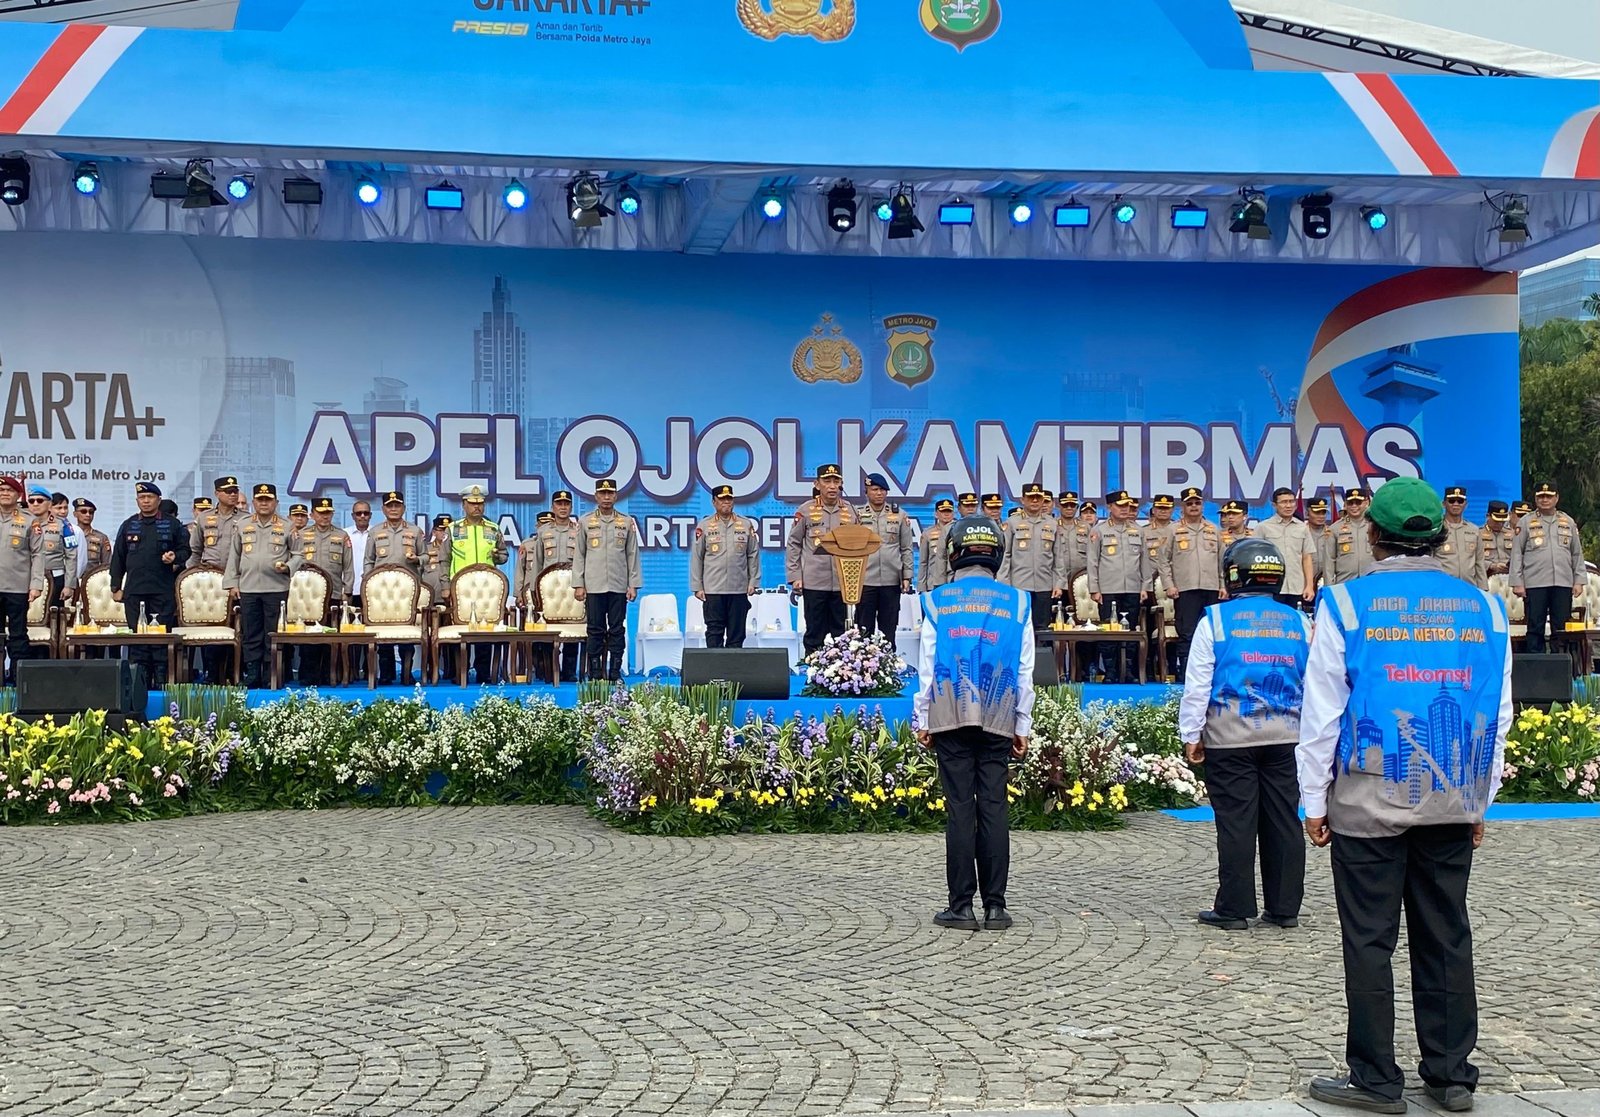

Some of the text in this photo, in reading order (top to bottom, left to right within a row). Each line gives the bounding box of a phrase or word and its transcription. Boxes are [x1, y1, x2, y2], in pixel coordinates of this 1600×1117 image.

[452, 20, 530, 36] PRESISI
[535, 21, 603, 32] Aman dan Tertib
[535, 32, 652, 45] Bersama Polda Metro Jaya
[888, 318, 932, 327] METRO JAYA
[0, 372, 165, 440] ARTA+
[29, 453, 53, 465] dan
[56, 453, 92, 465] Tertib
[288, 411, 1423, 500] APEL OJOL KAMTIBMAS
[49, 469, 87, 480] Polda
[91, 470, 130, 481] Metro
[134, 470, 166, 483] Jaya
[966, 526, 994, 535] OJOL
[1255, 555, 1280, 564] OJOL
[1367, 596, 1480, 613] JAGA JAKARTA
[1399, 613, 1455, 624] BERSAMA
[1365, 627, 1487, 644] POLDA METRO JAYA
[1241, 652, 1295, 664] Telkomse
